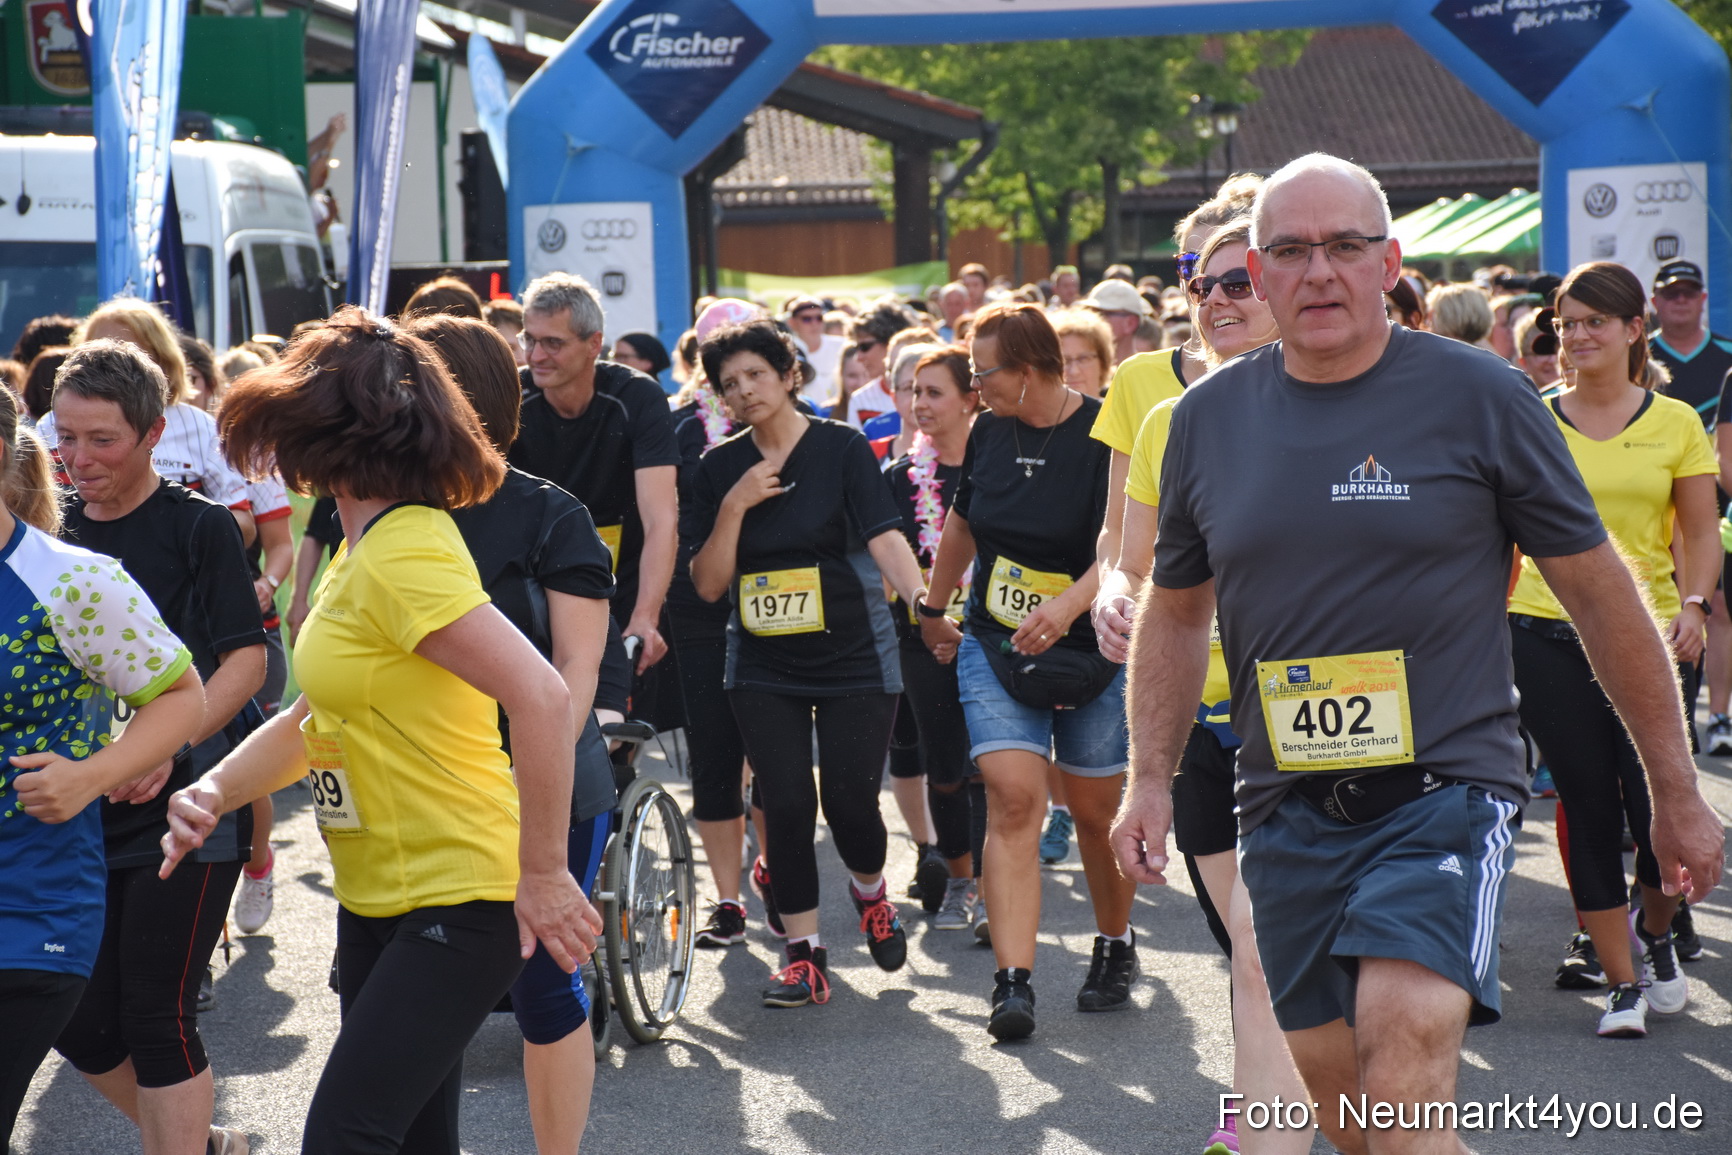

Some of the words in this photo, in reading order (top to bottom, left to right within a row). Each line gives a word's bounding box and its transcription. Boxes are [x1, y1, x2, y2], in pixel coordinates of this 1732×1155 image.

[631, 31, 745, 57] Fischer
[641, 55, 734, 69] AUTOMOBILE
[1332, 483, 1410, 495] BURKHARDT
[750, 592, 809, 618] 1977
[999, 584, 1043, 613] 198
[1279, 679, 1333, 693] firmenlauf
[1341, 681, 1367, 694] walk
[1369, 682, 1397, 693] 2019
[1292, 695, 1375, 739] 402
[1281, 740, 1347, 753] Berschneider
[1350, 734, 1399, 748] Gerhard
[1307, 752, 1342, 760] Burkhardt
[1343, 749, 1367, 758] GmbH
[1424, 781, 1442, 793] deuter
[1439, 864, 1463, 876] adidas
